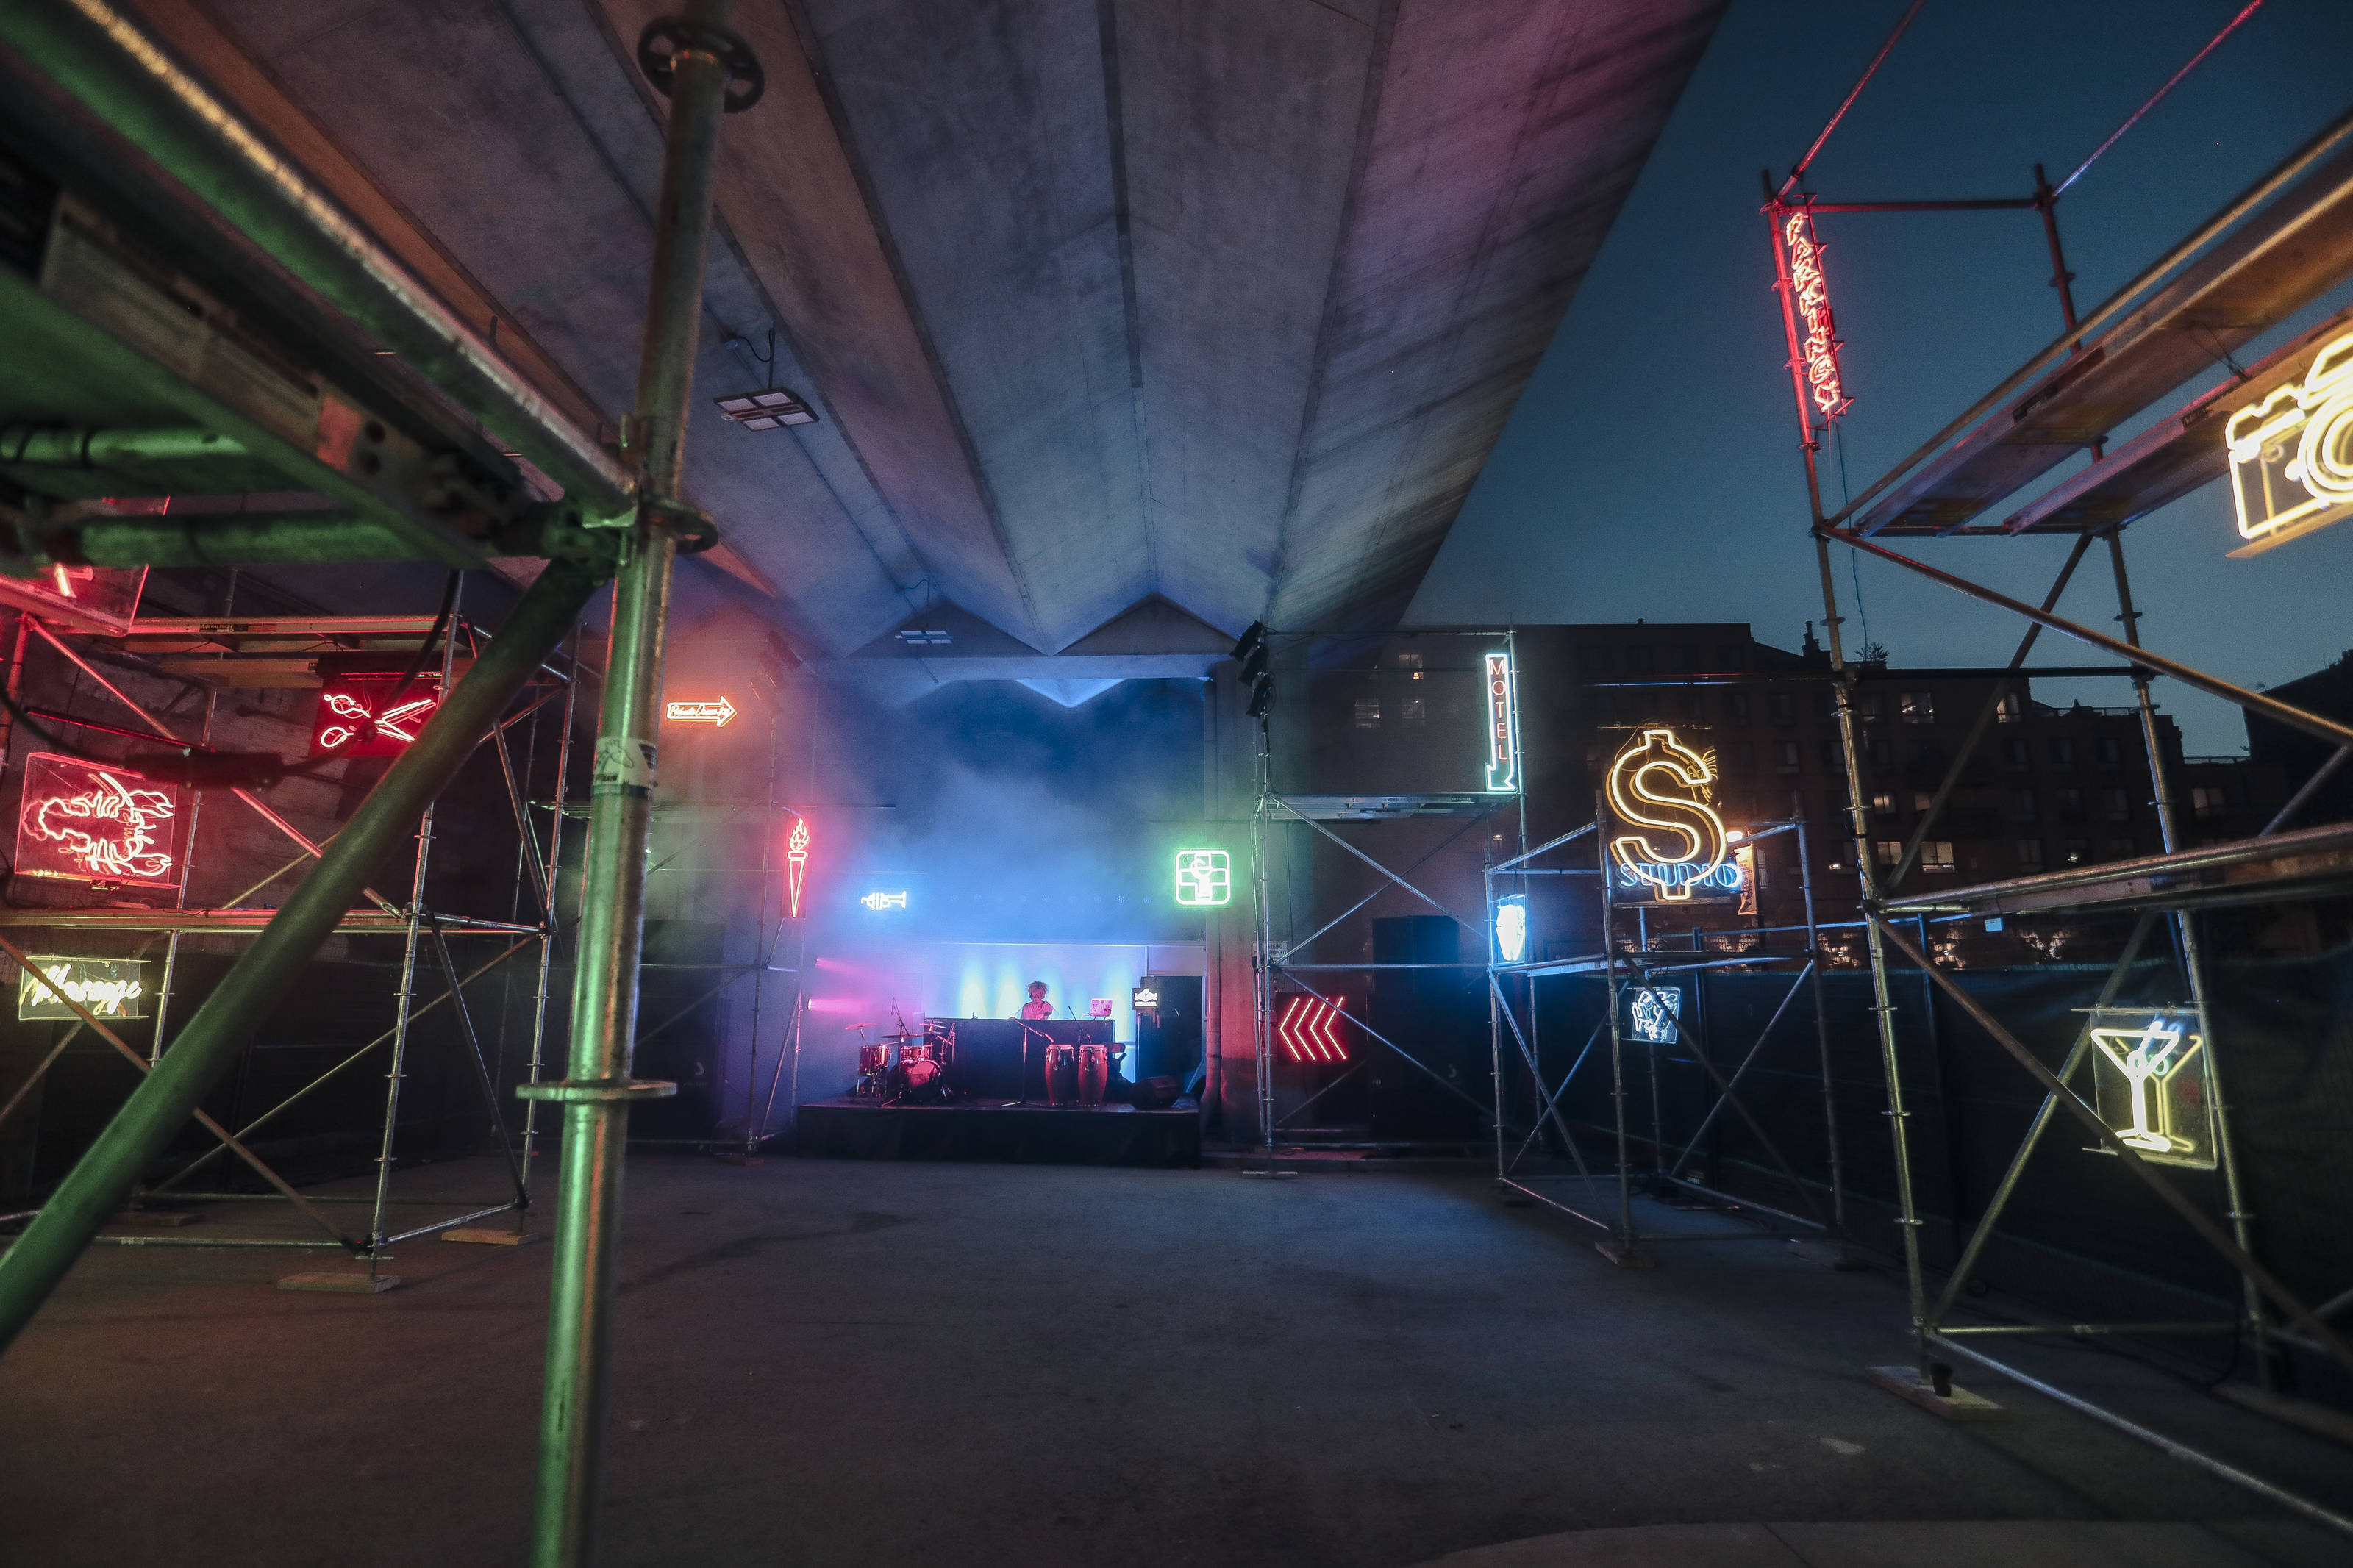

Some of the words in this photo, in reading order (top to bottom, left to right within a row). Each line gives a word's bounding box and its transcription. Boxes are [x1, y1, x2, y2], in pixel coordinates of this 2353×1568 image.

[1785, 212, 1836, 384] PARKING
[1490, 659, 1508, 761] MOTEL
[1620, 862, 1743, 887] STUDIO
